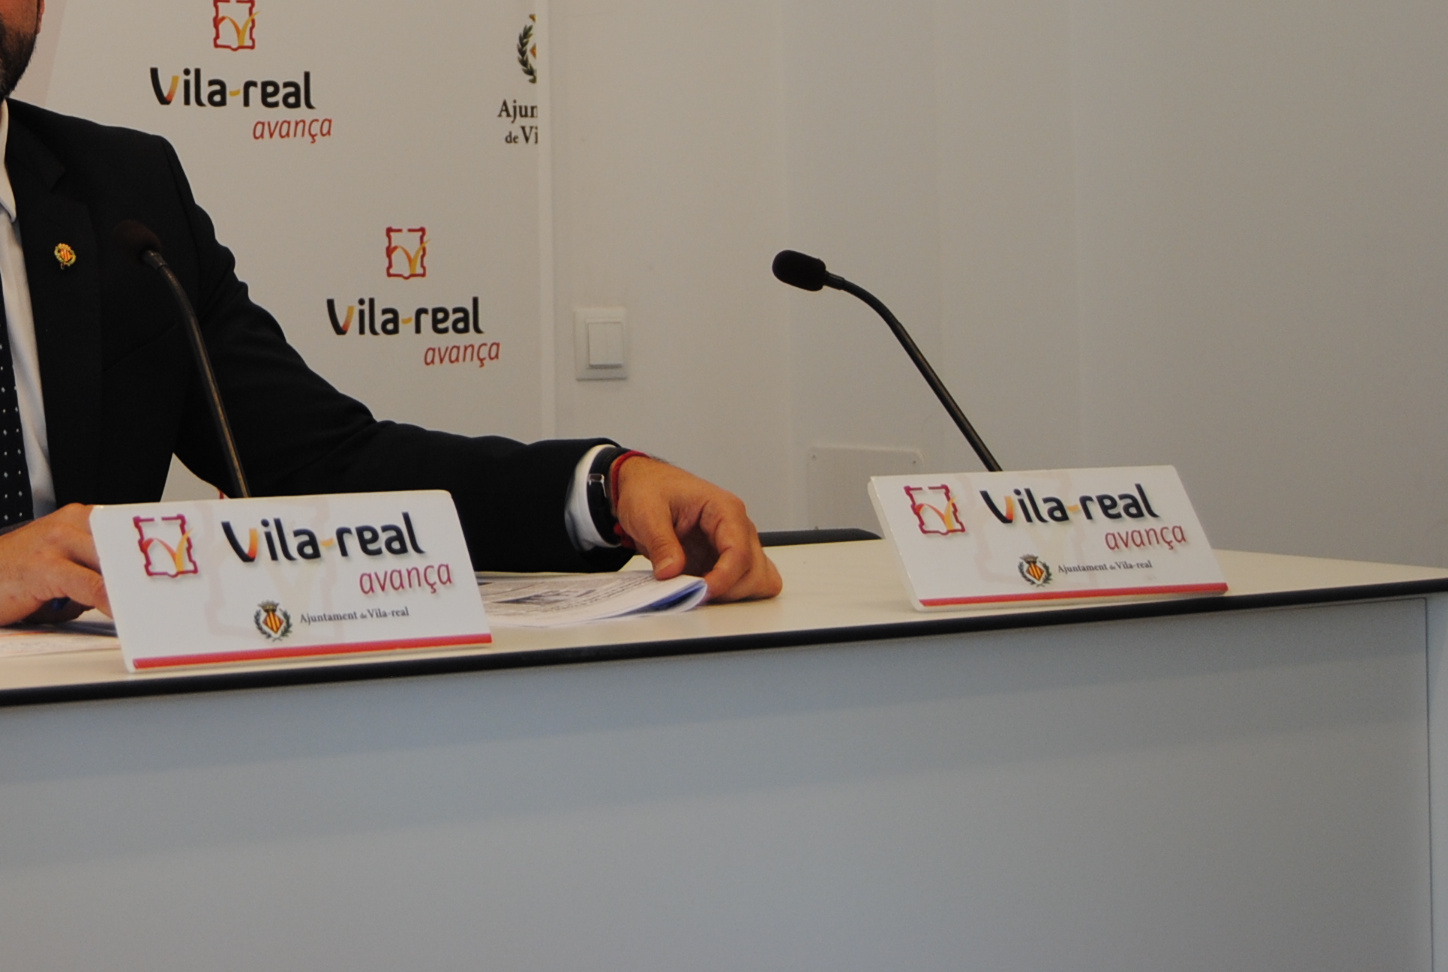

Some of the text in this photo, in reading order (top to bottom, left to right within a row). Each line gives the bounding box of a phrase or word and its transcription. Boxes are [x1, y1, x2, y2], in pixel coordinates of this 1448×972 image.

[150, 67, 315, 109] Vila-real
[253, 118, 332, 144] avança
[505, 131, 519, 144] de
[327, 297, 484, 336] Vila-real
[424, 342, 500, 368] avança
[980, 484, 1159, 524] Vila-real
[221, 512, 425, 563] Vila-real
[1105, 526, 1187, 550] avança
[360, 564, 452, 595] avança
[1058, 564, 1108, 574] Ajuntament
[1115, 560, 1152, 569] Vila-real
[300, 612, 357, 625] Ajuntament
[367, 606, 409, 618] Vila-real
